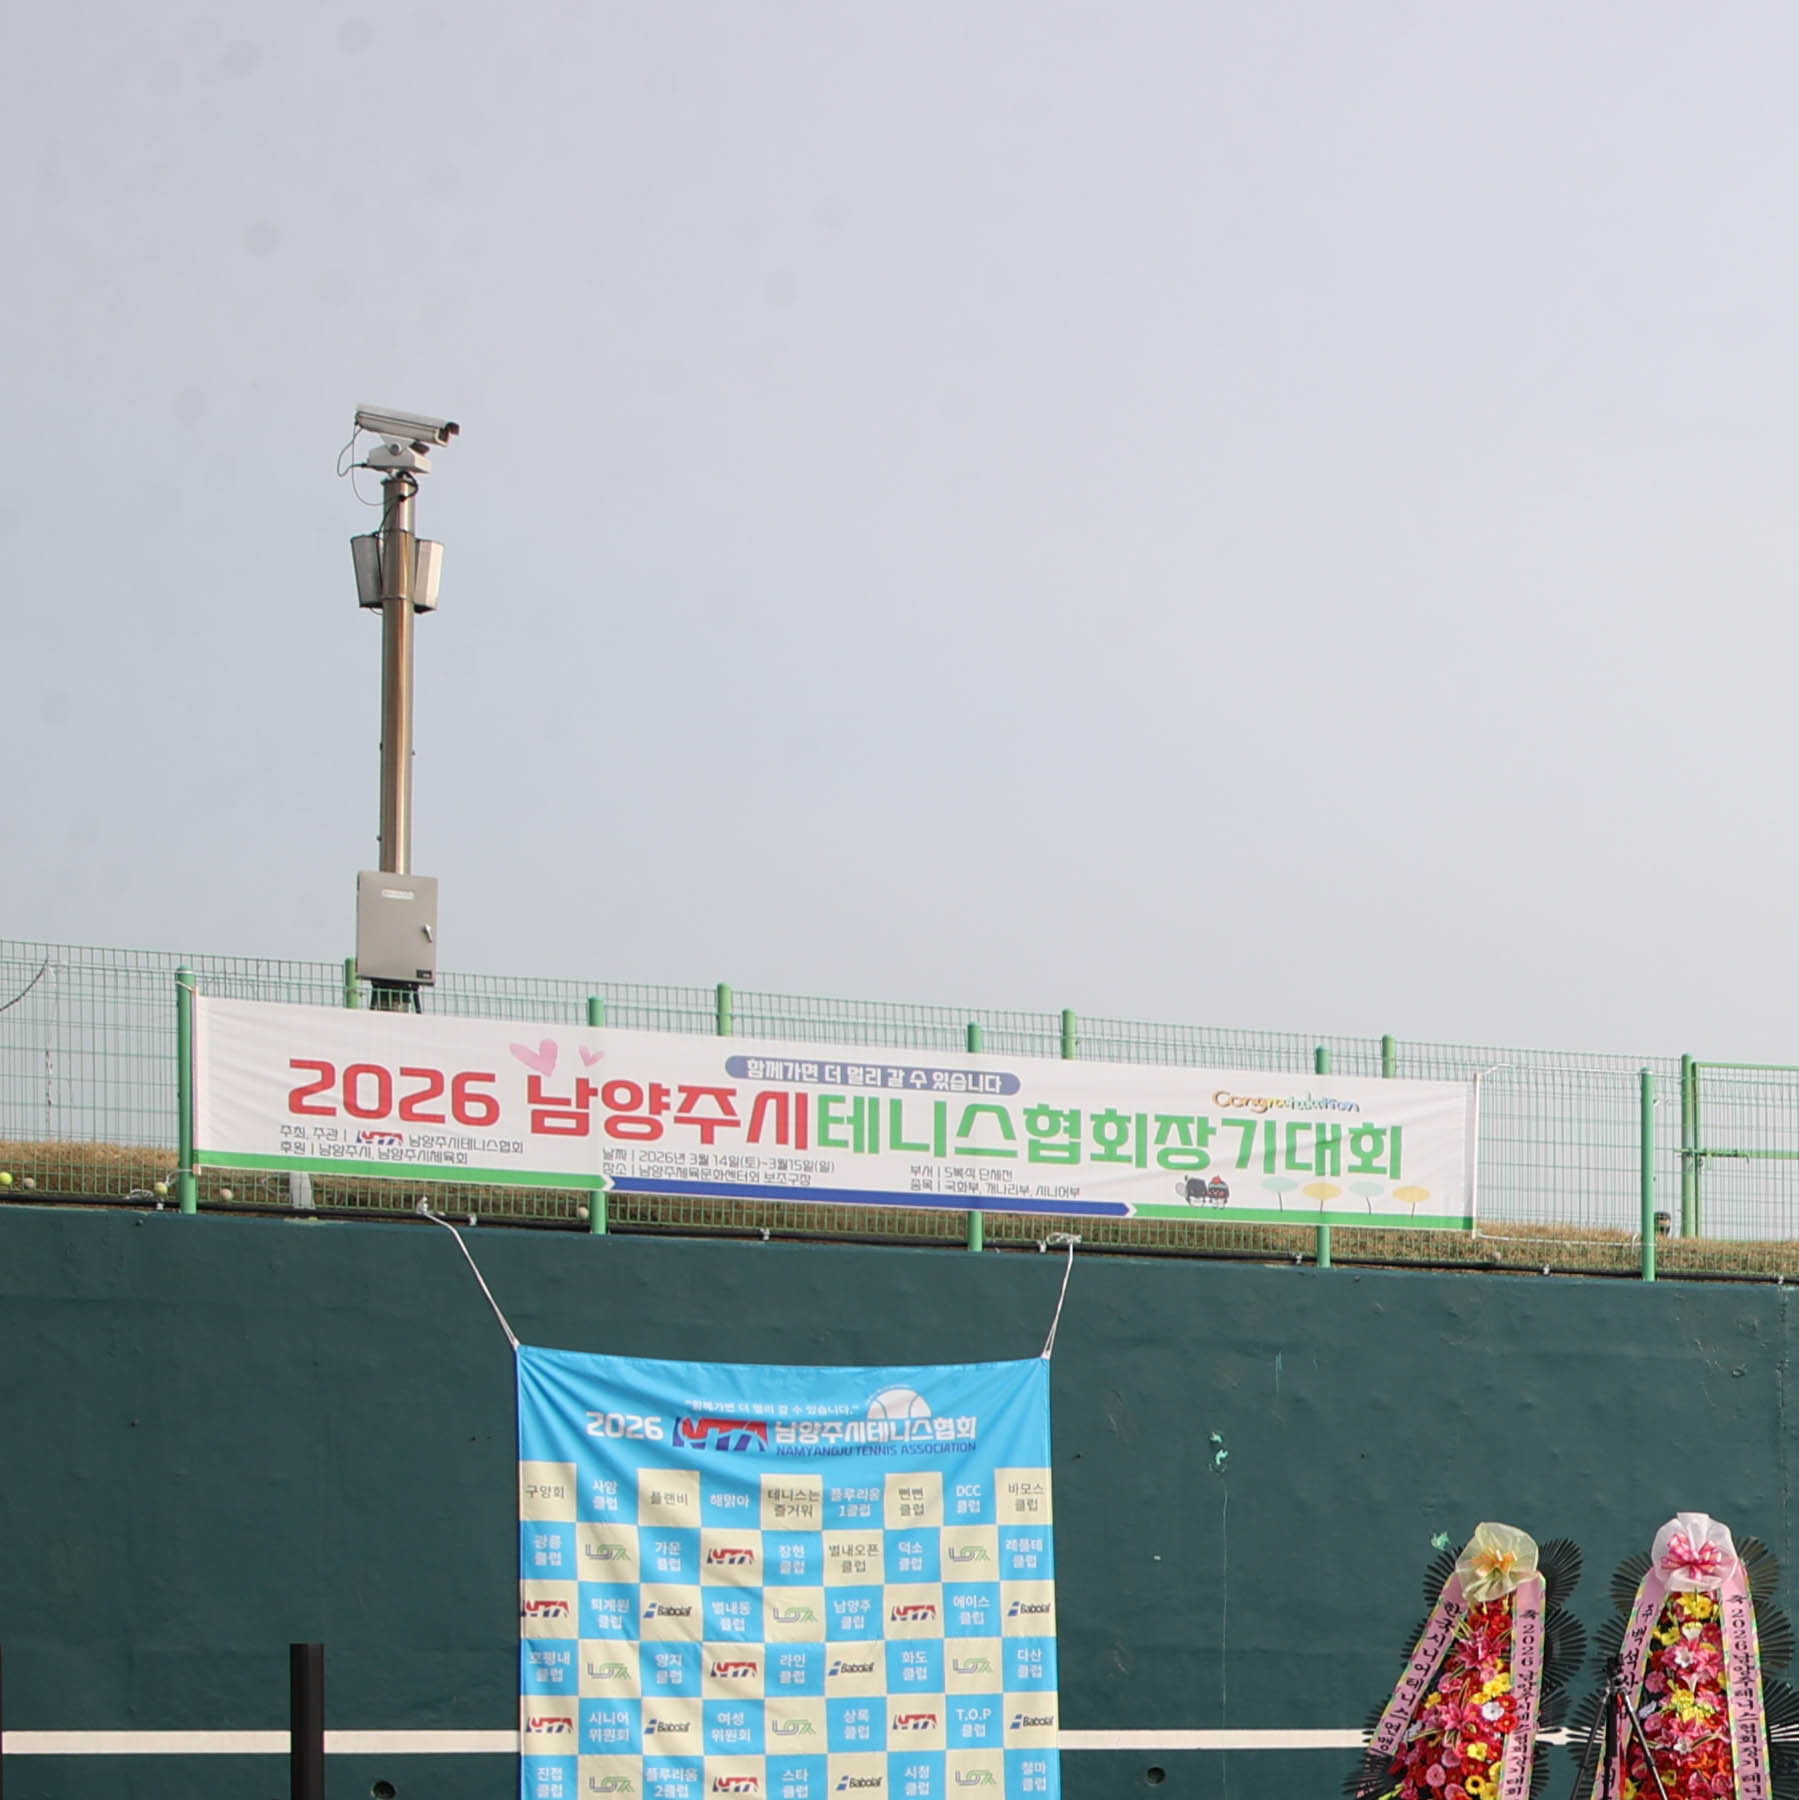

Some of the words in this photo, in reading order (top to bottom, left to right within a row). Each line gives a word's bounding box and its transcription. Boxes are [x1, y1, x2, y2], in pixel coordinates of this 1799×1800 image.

[746, 1058, 820, 1082] 함께가면
[824, 1062, 841, 1082] 더
[847, 1065, 881, 1086] 멀리
[887, 1067, 905, 1088] 갈
[910, 1070, 927, 1088] 수
[932, 1071, 1002, 1093] 있습니다
[288, 1058, 500, 1127] 2026
[527, 1074, 1403, 1180] 남양주시테니스협회장기대회
[408, 1134, 524, 1154] 남양주시테니스협회
[638, 1150, 686, 1166] 2026년
[585, 1411, 665, 1441] 2026
[775, 1416, 977, 1445] 남양주시테니스협회
[855, 1445, 898, 1457] TENNIS
[901, 1441, 977, 1456] ASSOCIATION
[767, 1488, 821, 1503] 테니스는
[956, 1484, 982, 1497] DCC
[774, 1503, 814, 1518] 즐거워
[1730, 1608, 1748, 1652] 2026
[1520, 1623, 1536, 1668] 2026
[955, 1708, 992, 1721] T.O.P
